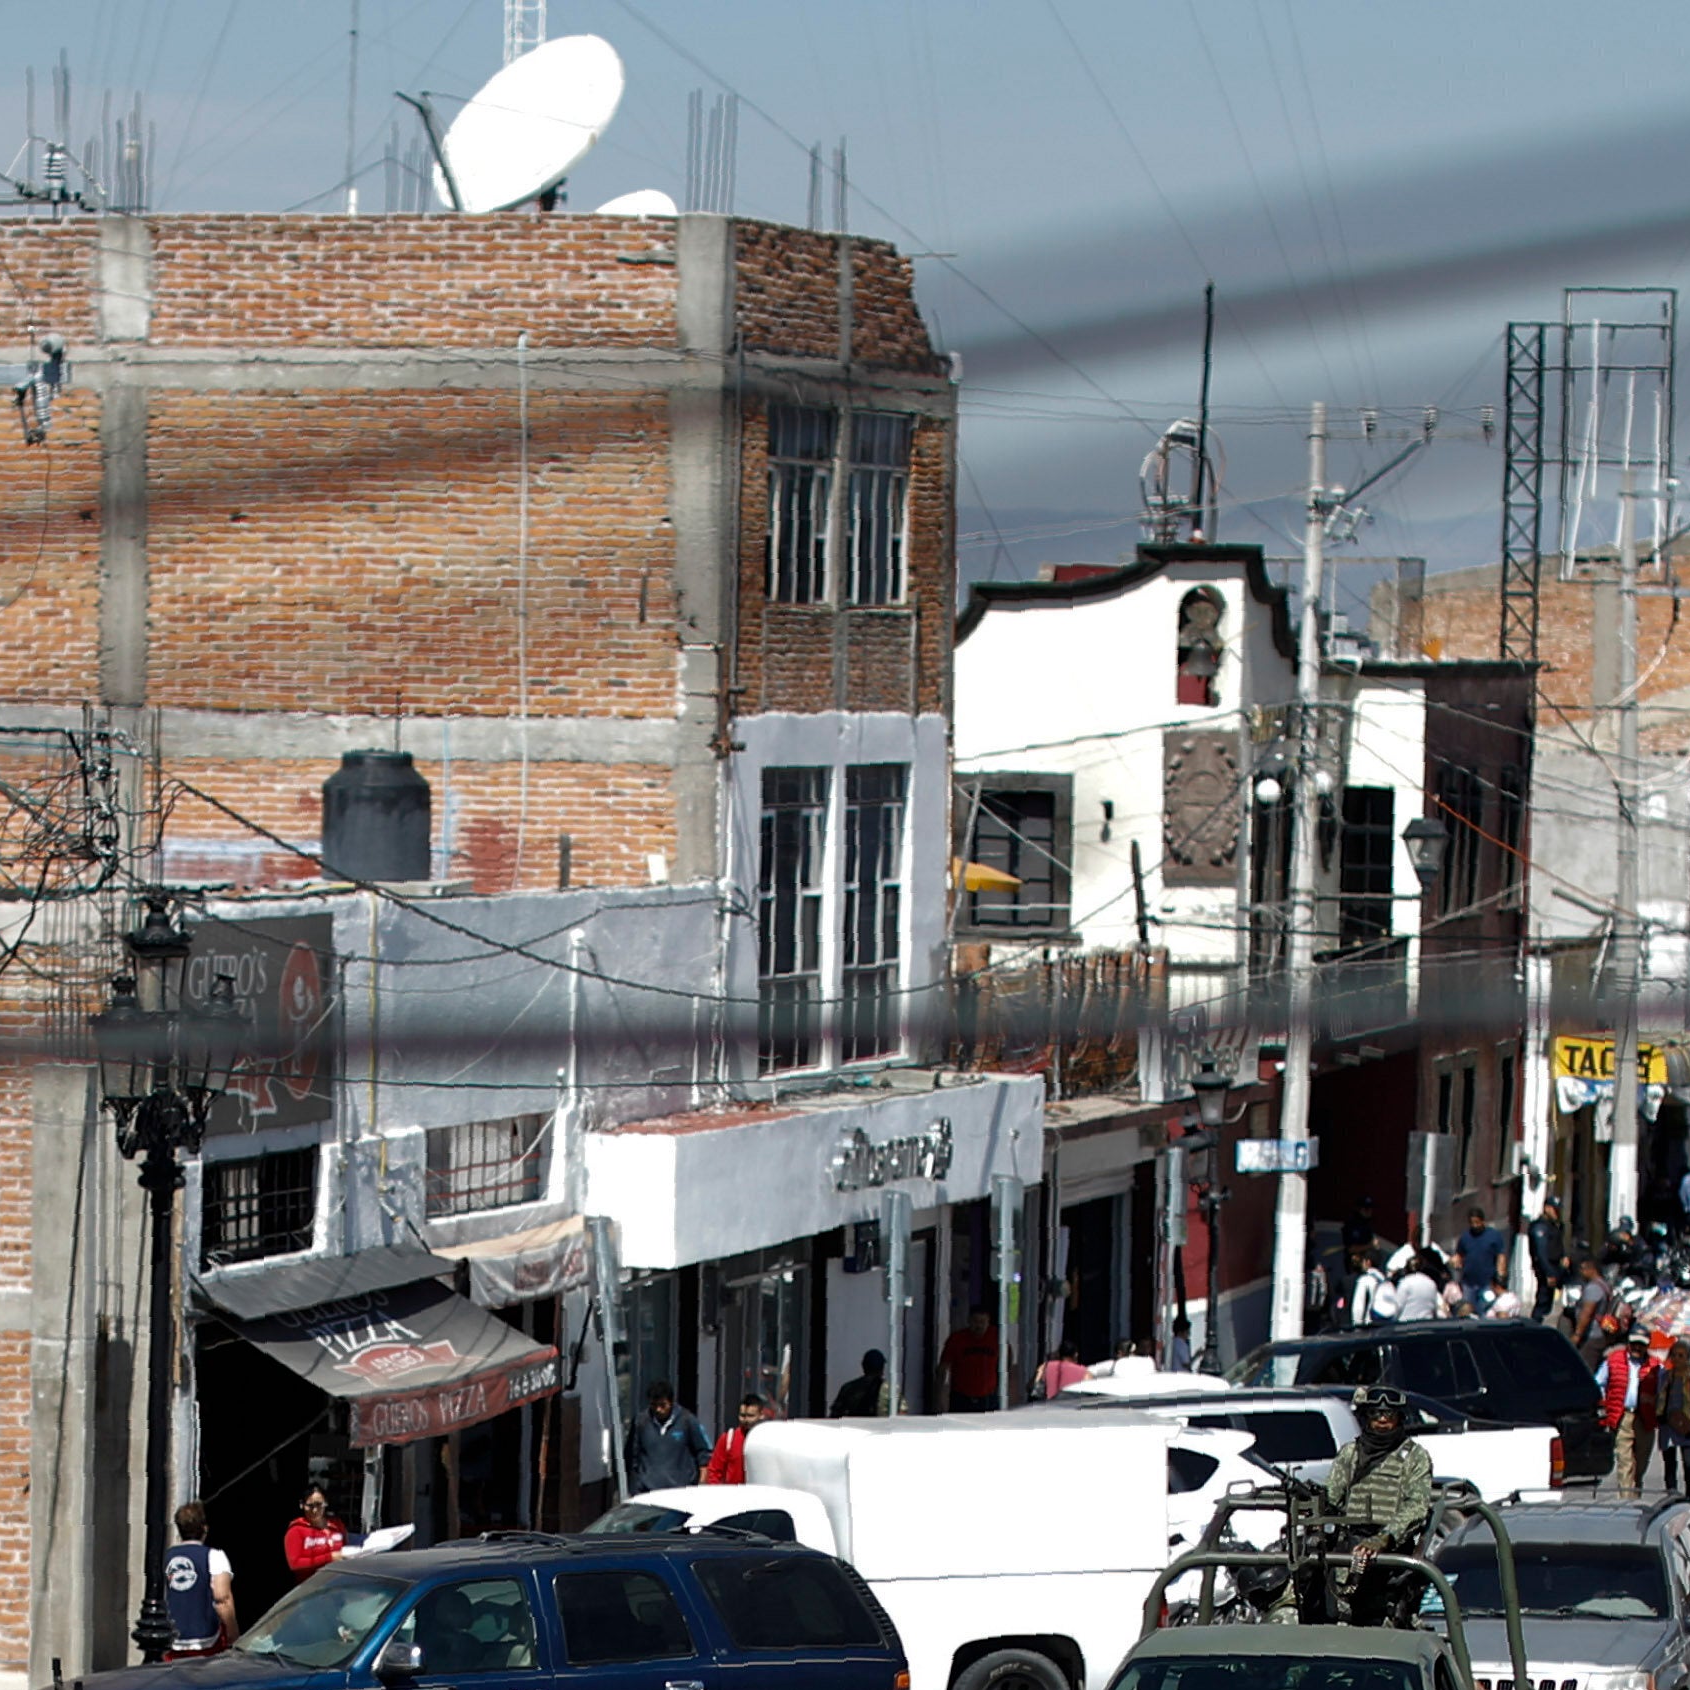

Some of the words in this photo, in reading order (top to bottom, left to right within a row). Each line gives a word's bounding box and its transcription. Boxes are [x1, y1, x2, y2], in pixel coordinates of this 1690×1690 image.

[1564, 1045, 1654, 1079] TACS
[306, 1311, 423, 1360] PIZZA
[439, 1383, 487, 1425] PIZZA
